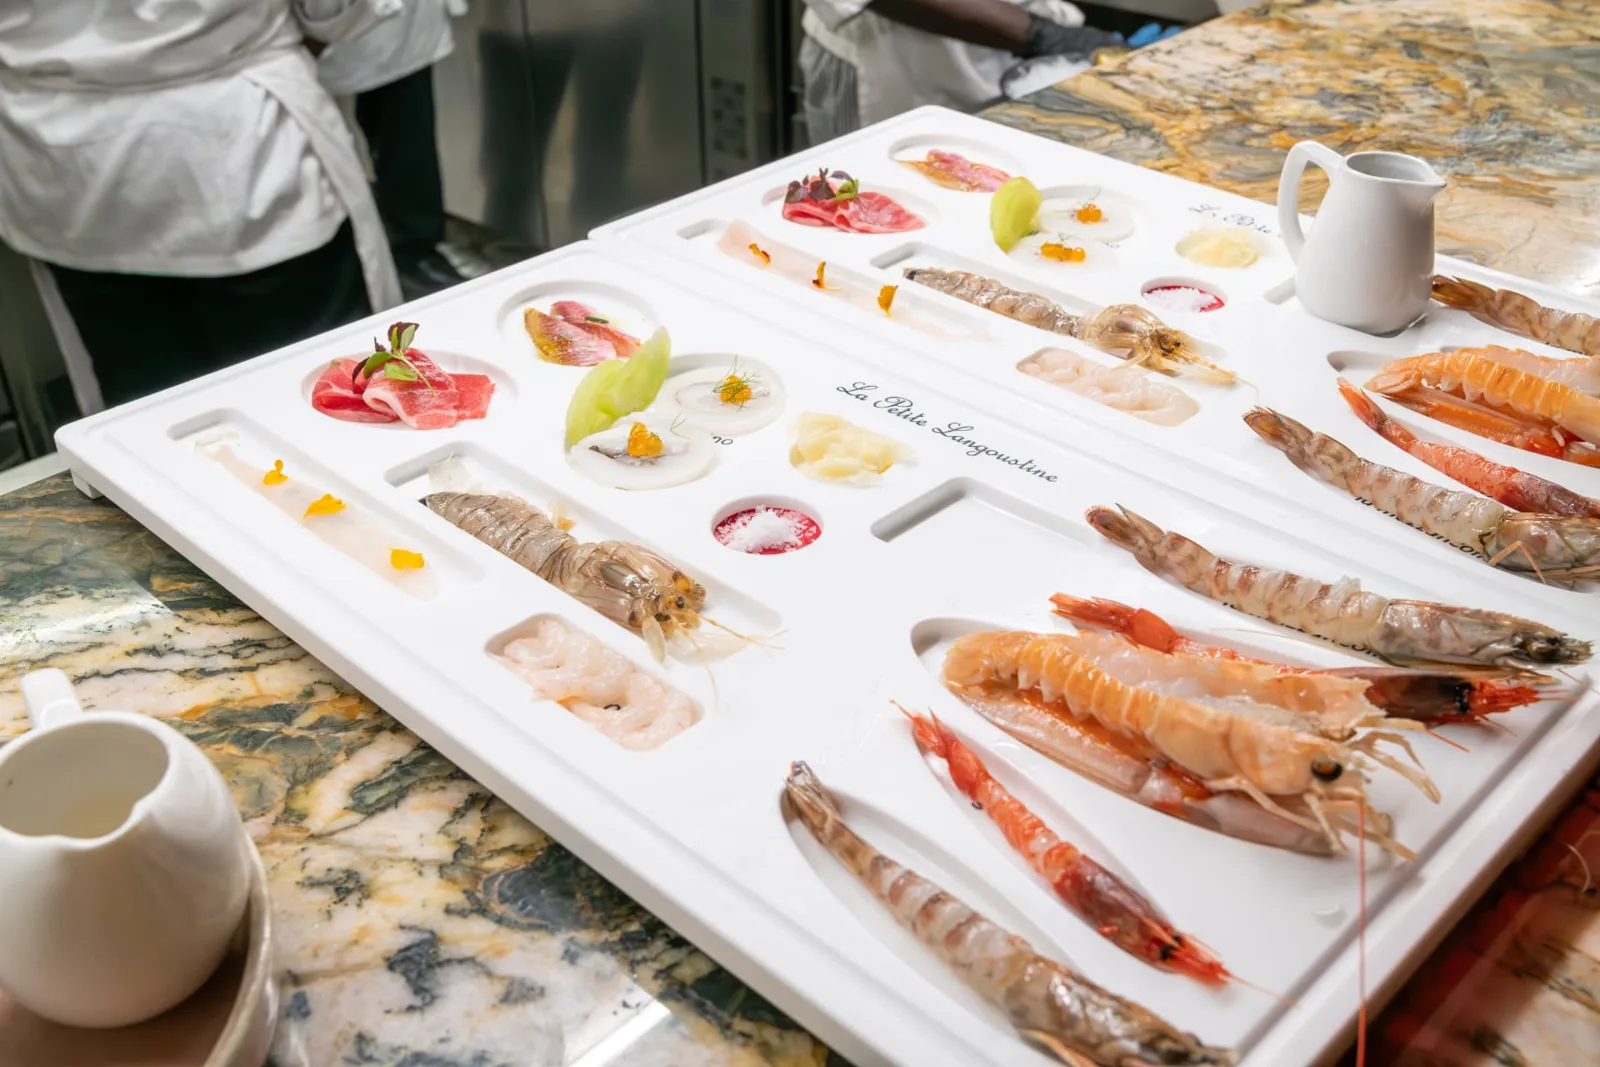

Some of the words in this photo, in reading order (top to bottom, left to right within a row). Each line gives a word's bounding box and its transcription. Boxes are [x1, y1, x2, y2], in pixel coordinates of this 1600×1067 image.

[836, 381, 879, 402] La
[873, 395, 928, 428] Petite
[931, 421, 1059, 484] Langoustine
